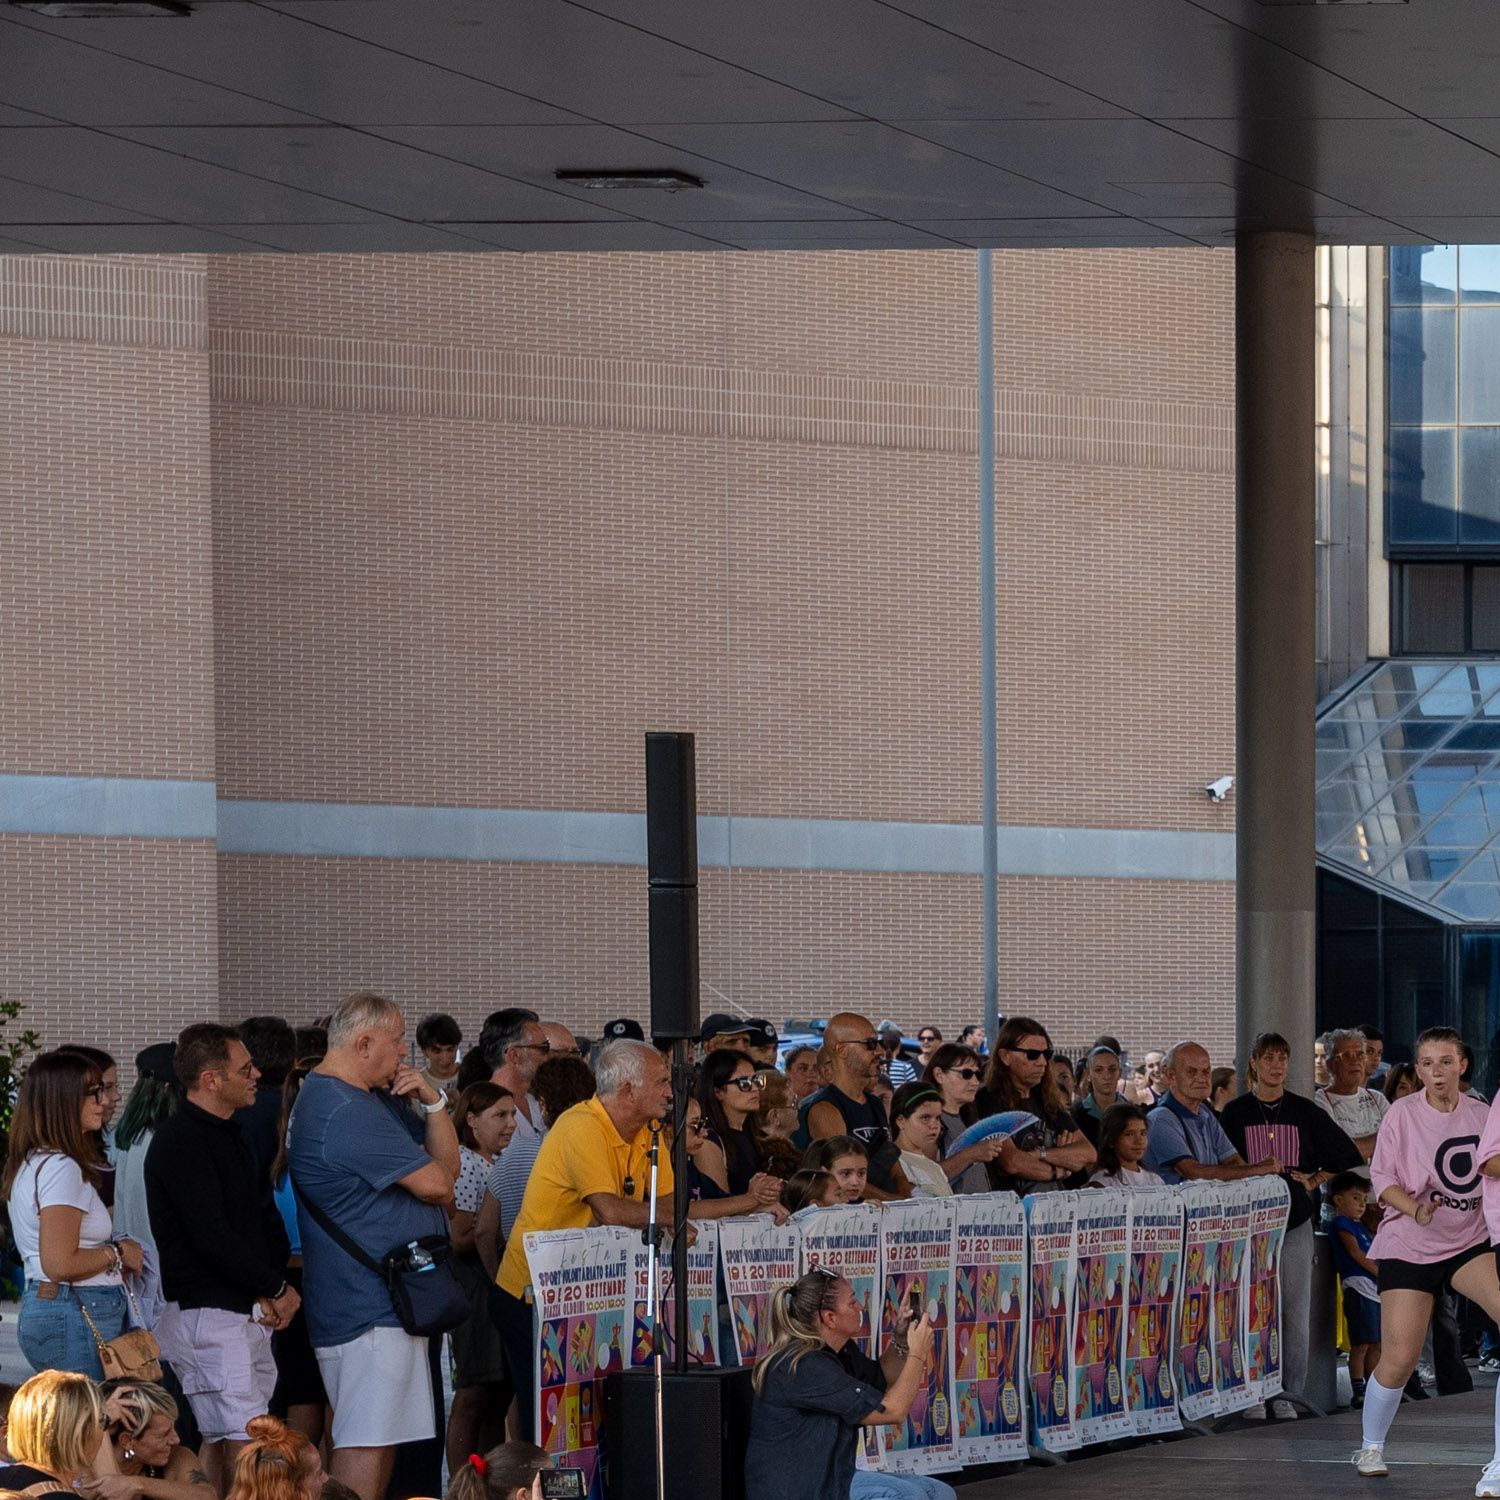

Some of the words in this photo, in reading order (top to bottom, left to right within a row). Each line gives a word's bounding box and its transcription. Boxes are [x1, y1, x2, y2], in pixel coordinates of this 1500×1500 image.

[830, 1252, 842, 1265] 20
[904, 1246, 918, 1260] 20
[750, 1265, 764, 1280] 20
[564, 1284, 582, 1302] 20
